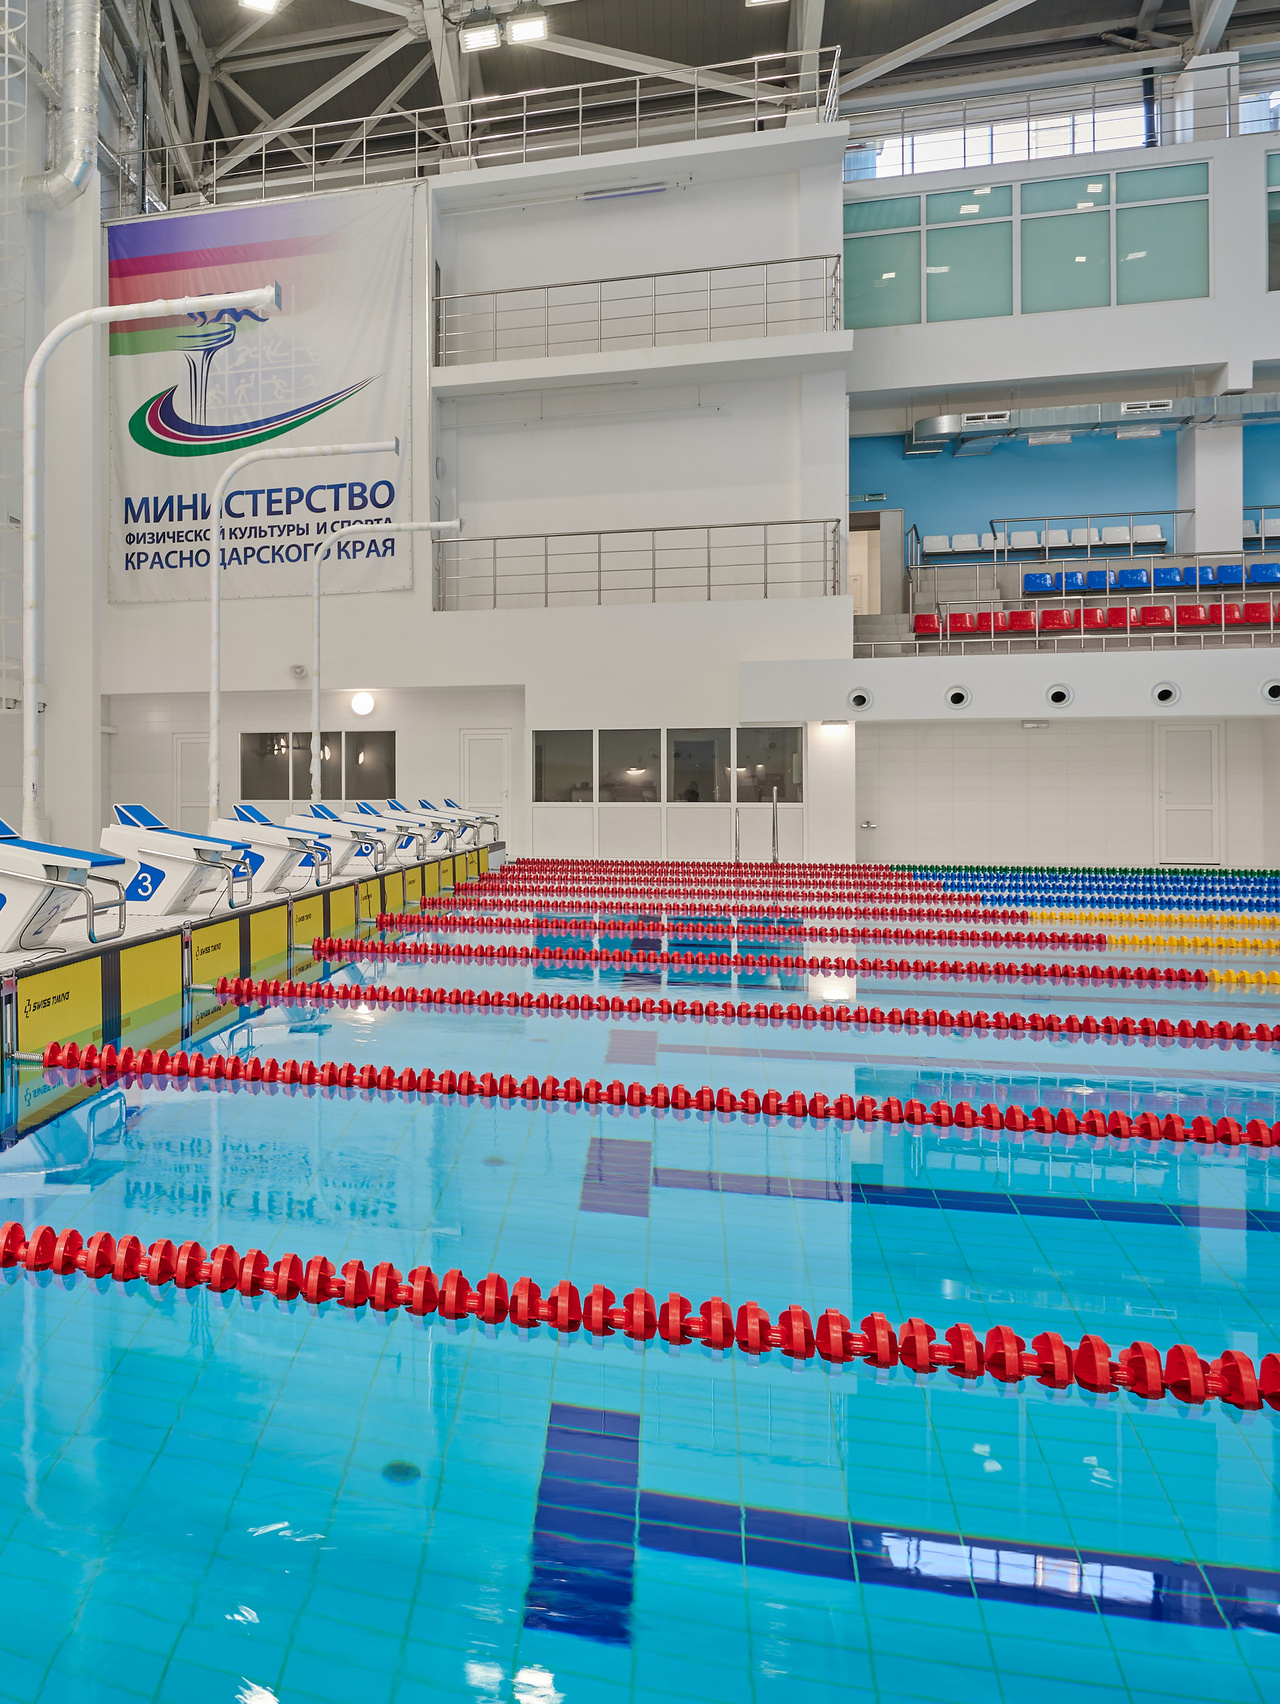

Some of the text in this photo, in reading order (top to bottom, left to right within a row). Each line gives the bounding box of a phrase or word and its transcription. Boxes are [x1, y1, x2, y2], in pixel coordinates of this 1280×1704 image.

[229, 523, 309, 540] КУЛЬТУРЫ
[316, 521, 328, 535] И
[337, 537, 395, 561] КРАЯ
[137, 872, 153, 896] 3
